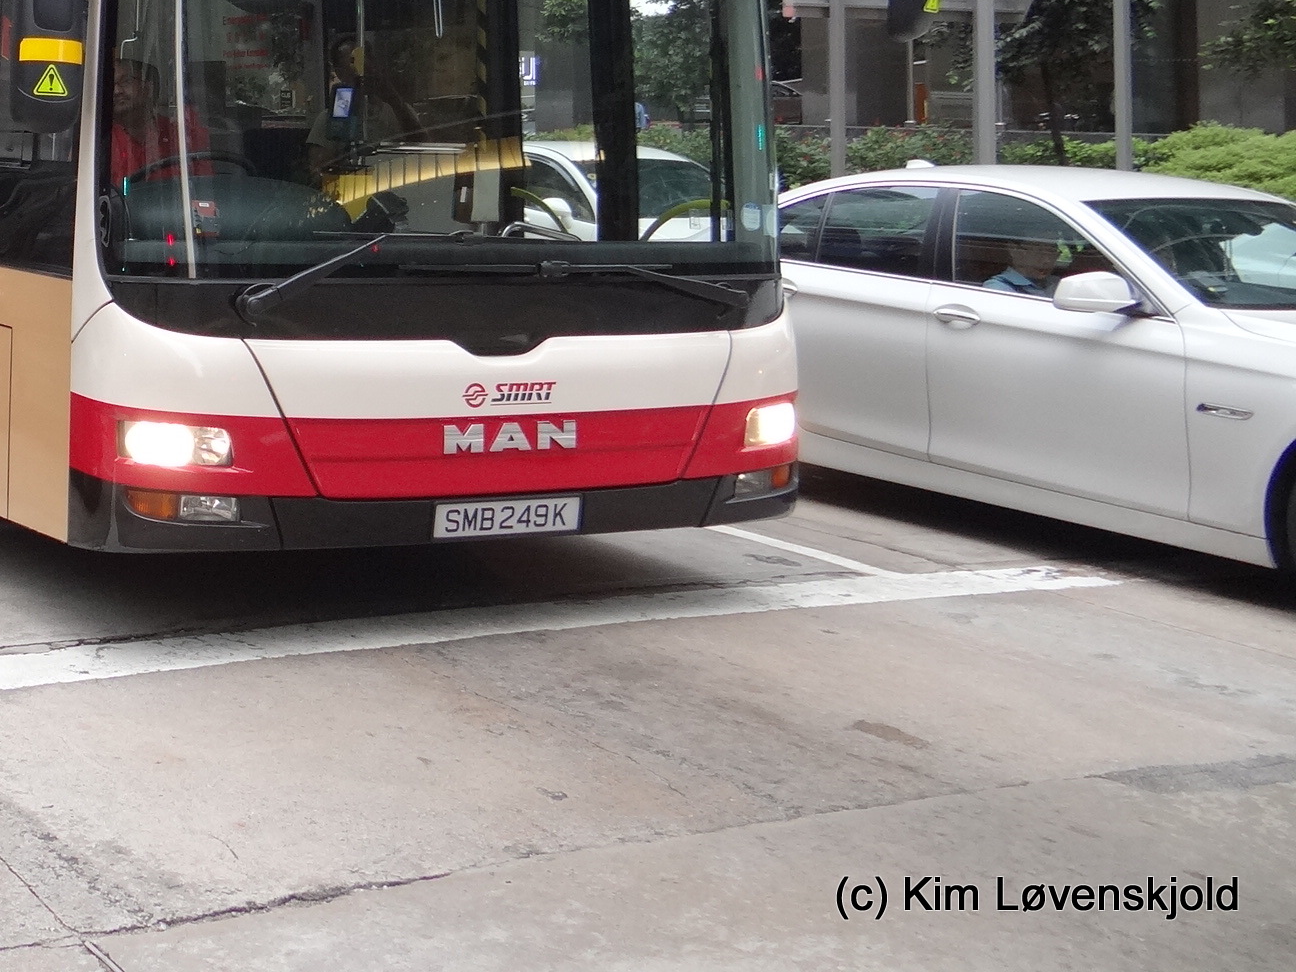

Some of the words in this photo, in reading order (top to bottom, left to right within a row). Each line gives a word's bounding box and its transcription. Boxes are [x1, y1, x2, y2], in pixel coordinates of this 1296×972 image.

[491, 381, 557, 403] SMRT
[442, 419, 577, 455] MAN
[445, 503, 567, 533] SMB249K
